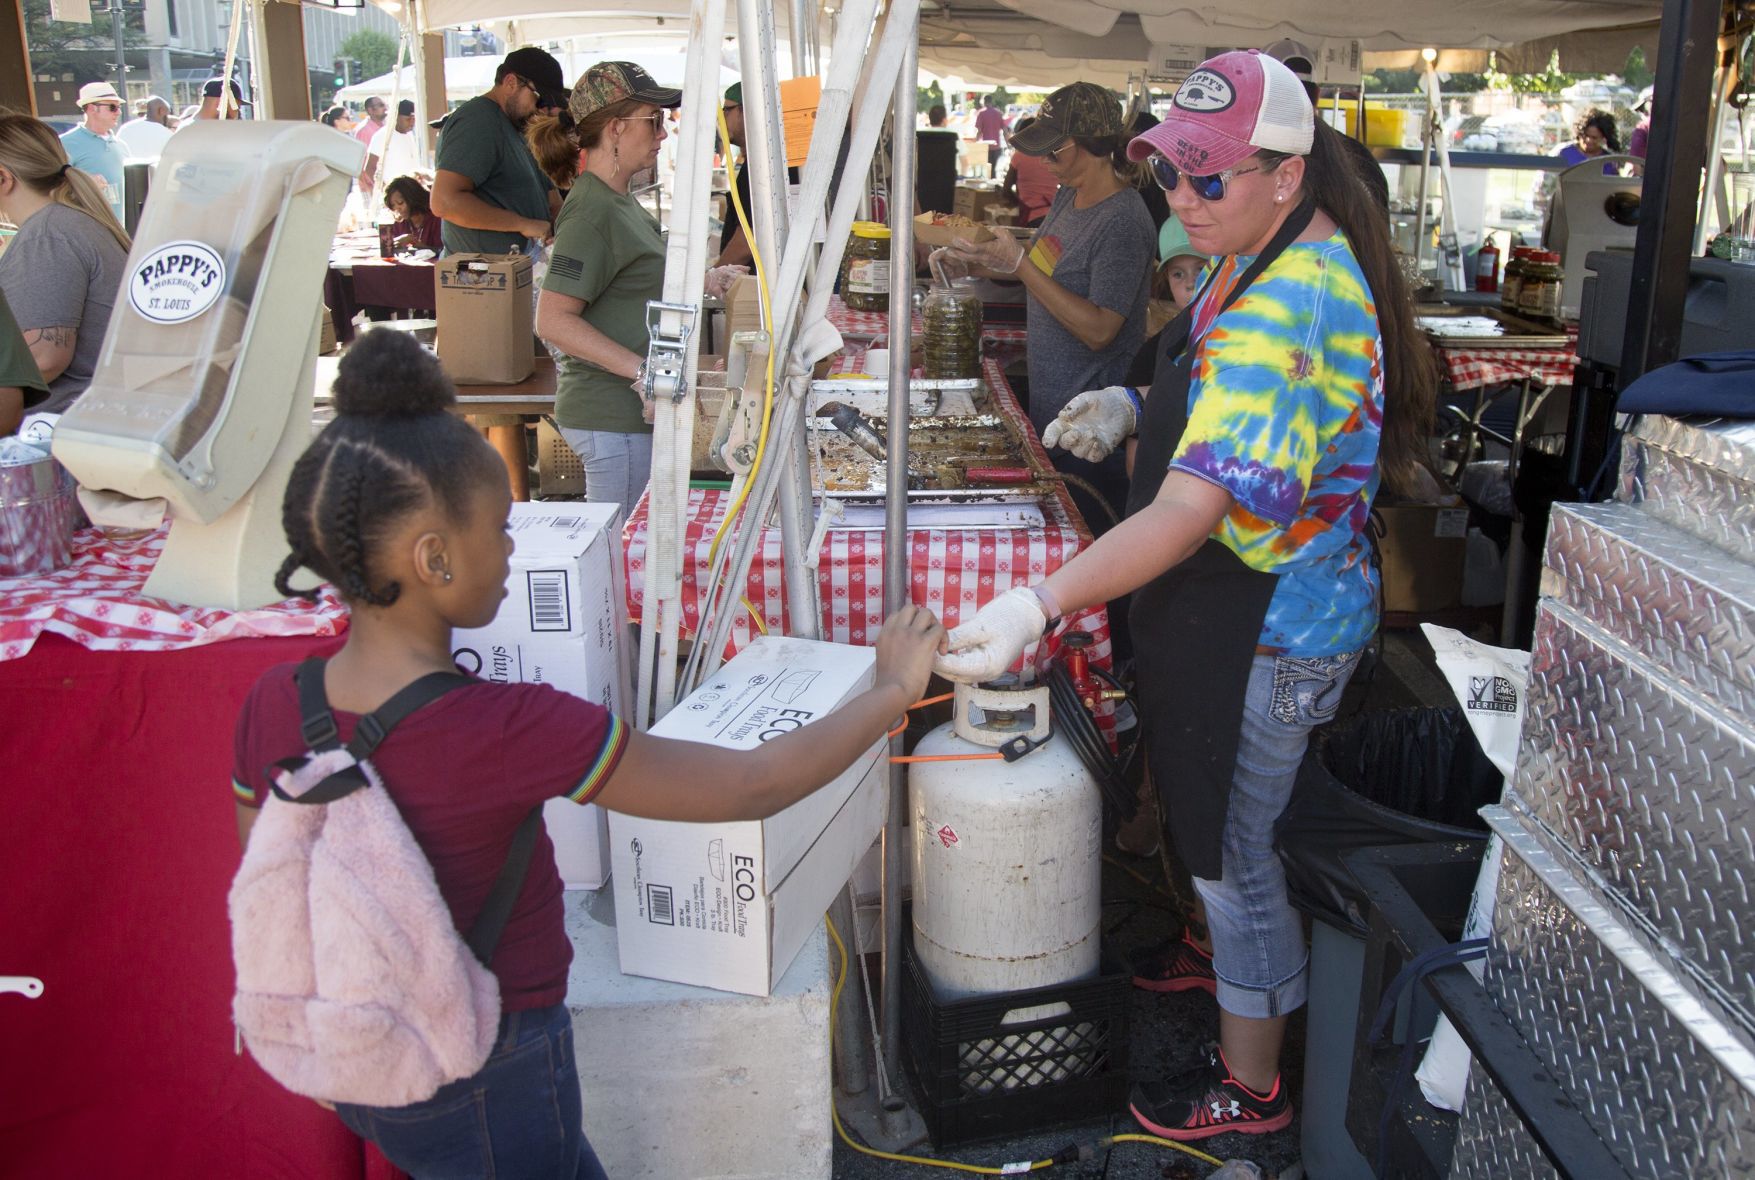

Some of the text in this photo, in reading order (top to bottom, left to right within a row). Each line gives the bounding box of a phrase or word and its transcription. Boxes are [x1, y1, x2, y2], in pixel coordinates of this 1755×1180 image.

[1185, 75, 1224, 91] PAPPY'S
[140, 254, 217, 287] PAPPY'S
[148, 298, 191, 310] ST. LOUIS
[489, 646, 513, 683] Trays
[1495, 686, 1516, 696] GMO
[1469, 701, 1515, 711] VERIFIED
[734, 856, 755, 902] ECO
[737, 902, 747, 919] Food
